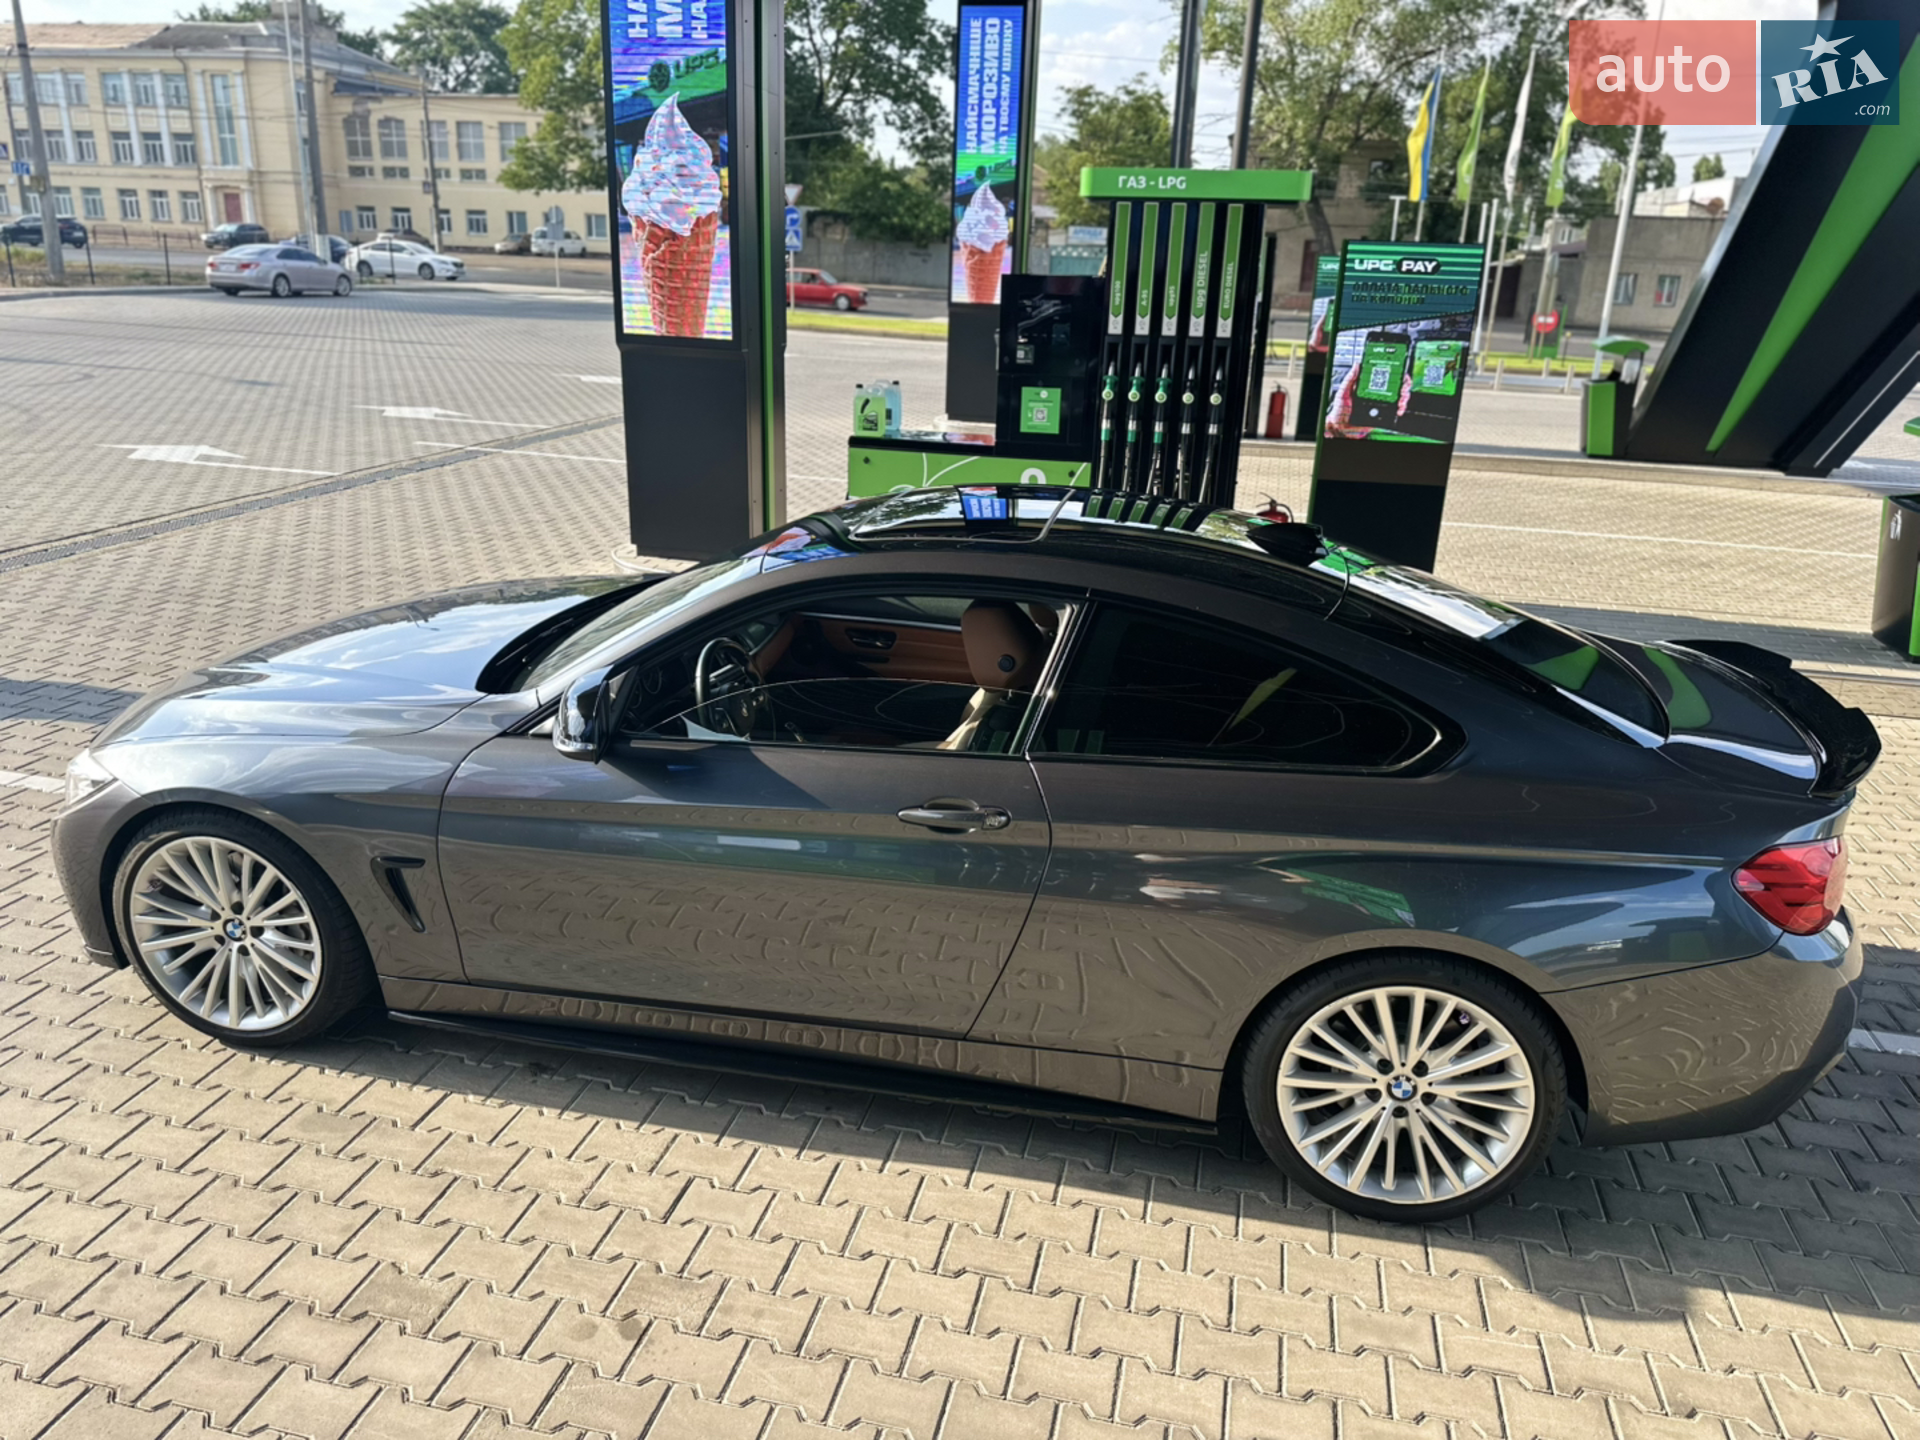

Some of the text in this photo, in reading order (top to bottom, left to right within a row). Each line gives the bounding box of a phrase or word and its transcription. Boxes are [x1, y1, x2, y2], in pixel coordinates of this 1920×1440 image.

[965, 17, 982, 154] НАЙСМАЧНІШЕ
[981, 17, 1000, 154] МОРОЗИВО
[999, 19, 1013, 154] НА ТВОЄМУ ШЛЯХУ
[1118, 175, 1147, 189] ГАЗ
[1158, 176, 1187, 190] LPG
[1196, 251, 1208, 308] upg DIESEL
[1223, 262, 1234, 309] EURO DIESEL
[1353, 259, 1437, 273] UPG PAY
